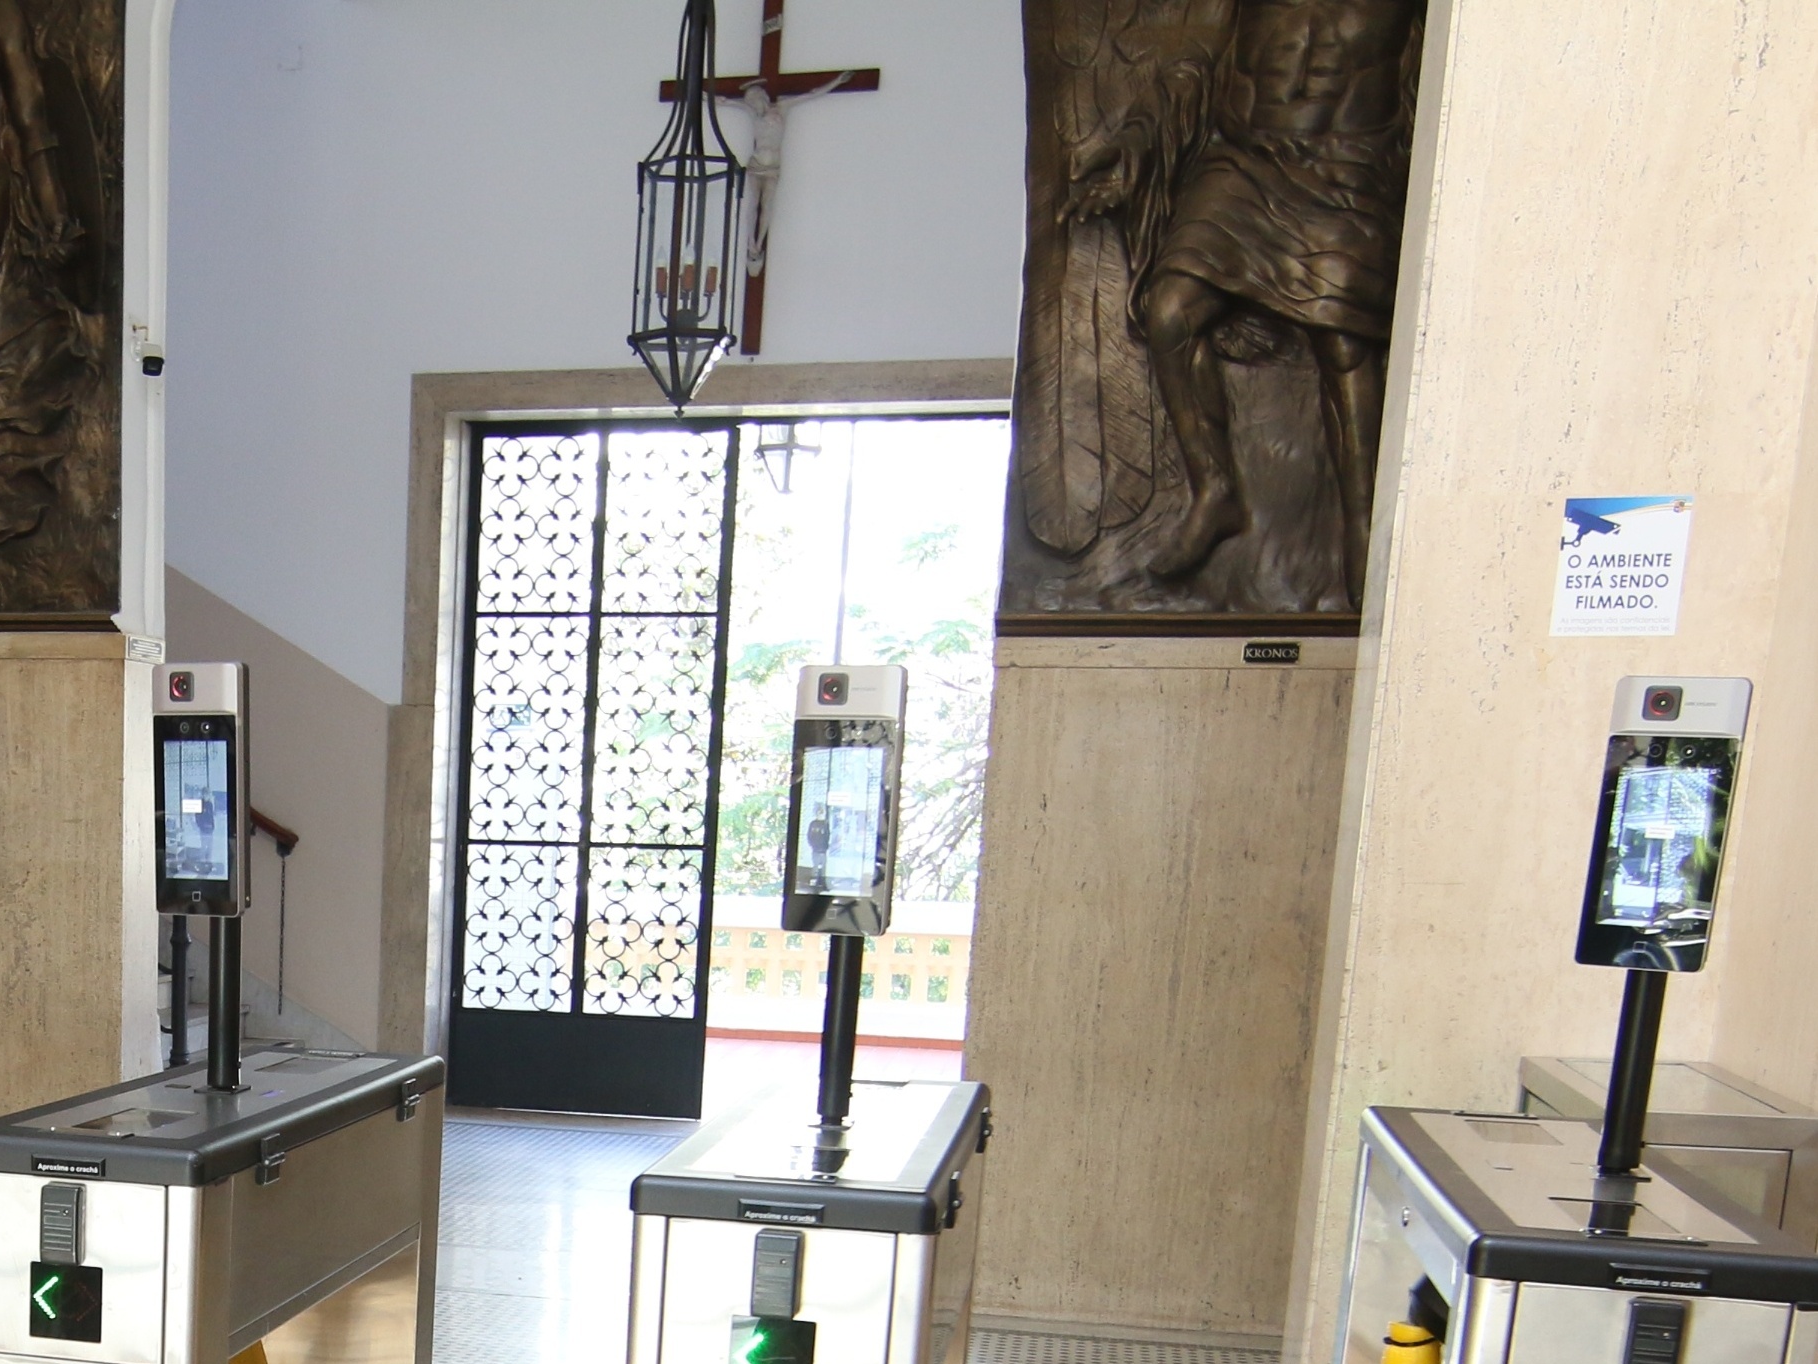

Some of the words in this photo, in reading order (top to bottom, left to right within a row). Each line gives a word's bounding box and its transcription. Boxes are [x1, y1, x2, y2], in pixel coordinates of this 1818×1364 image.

[1567, 554, 1582, 569] O
[1587, 553, 1673, 568] AMBIENTE
[1565, 571, 1603, 589] ESTÁ
[1609, 573, 1670, 589] SENDO
[1575, 594, 1658, 610] FILMADO.
[1245, 648, 1298, 659] KRONOS
[37, 1162, 69, 1172] Aproxime
[75, 1166, 99, 1174] crachá
[1615, 1275, 1661, 1286] Aproxime
